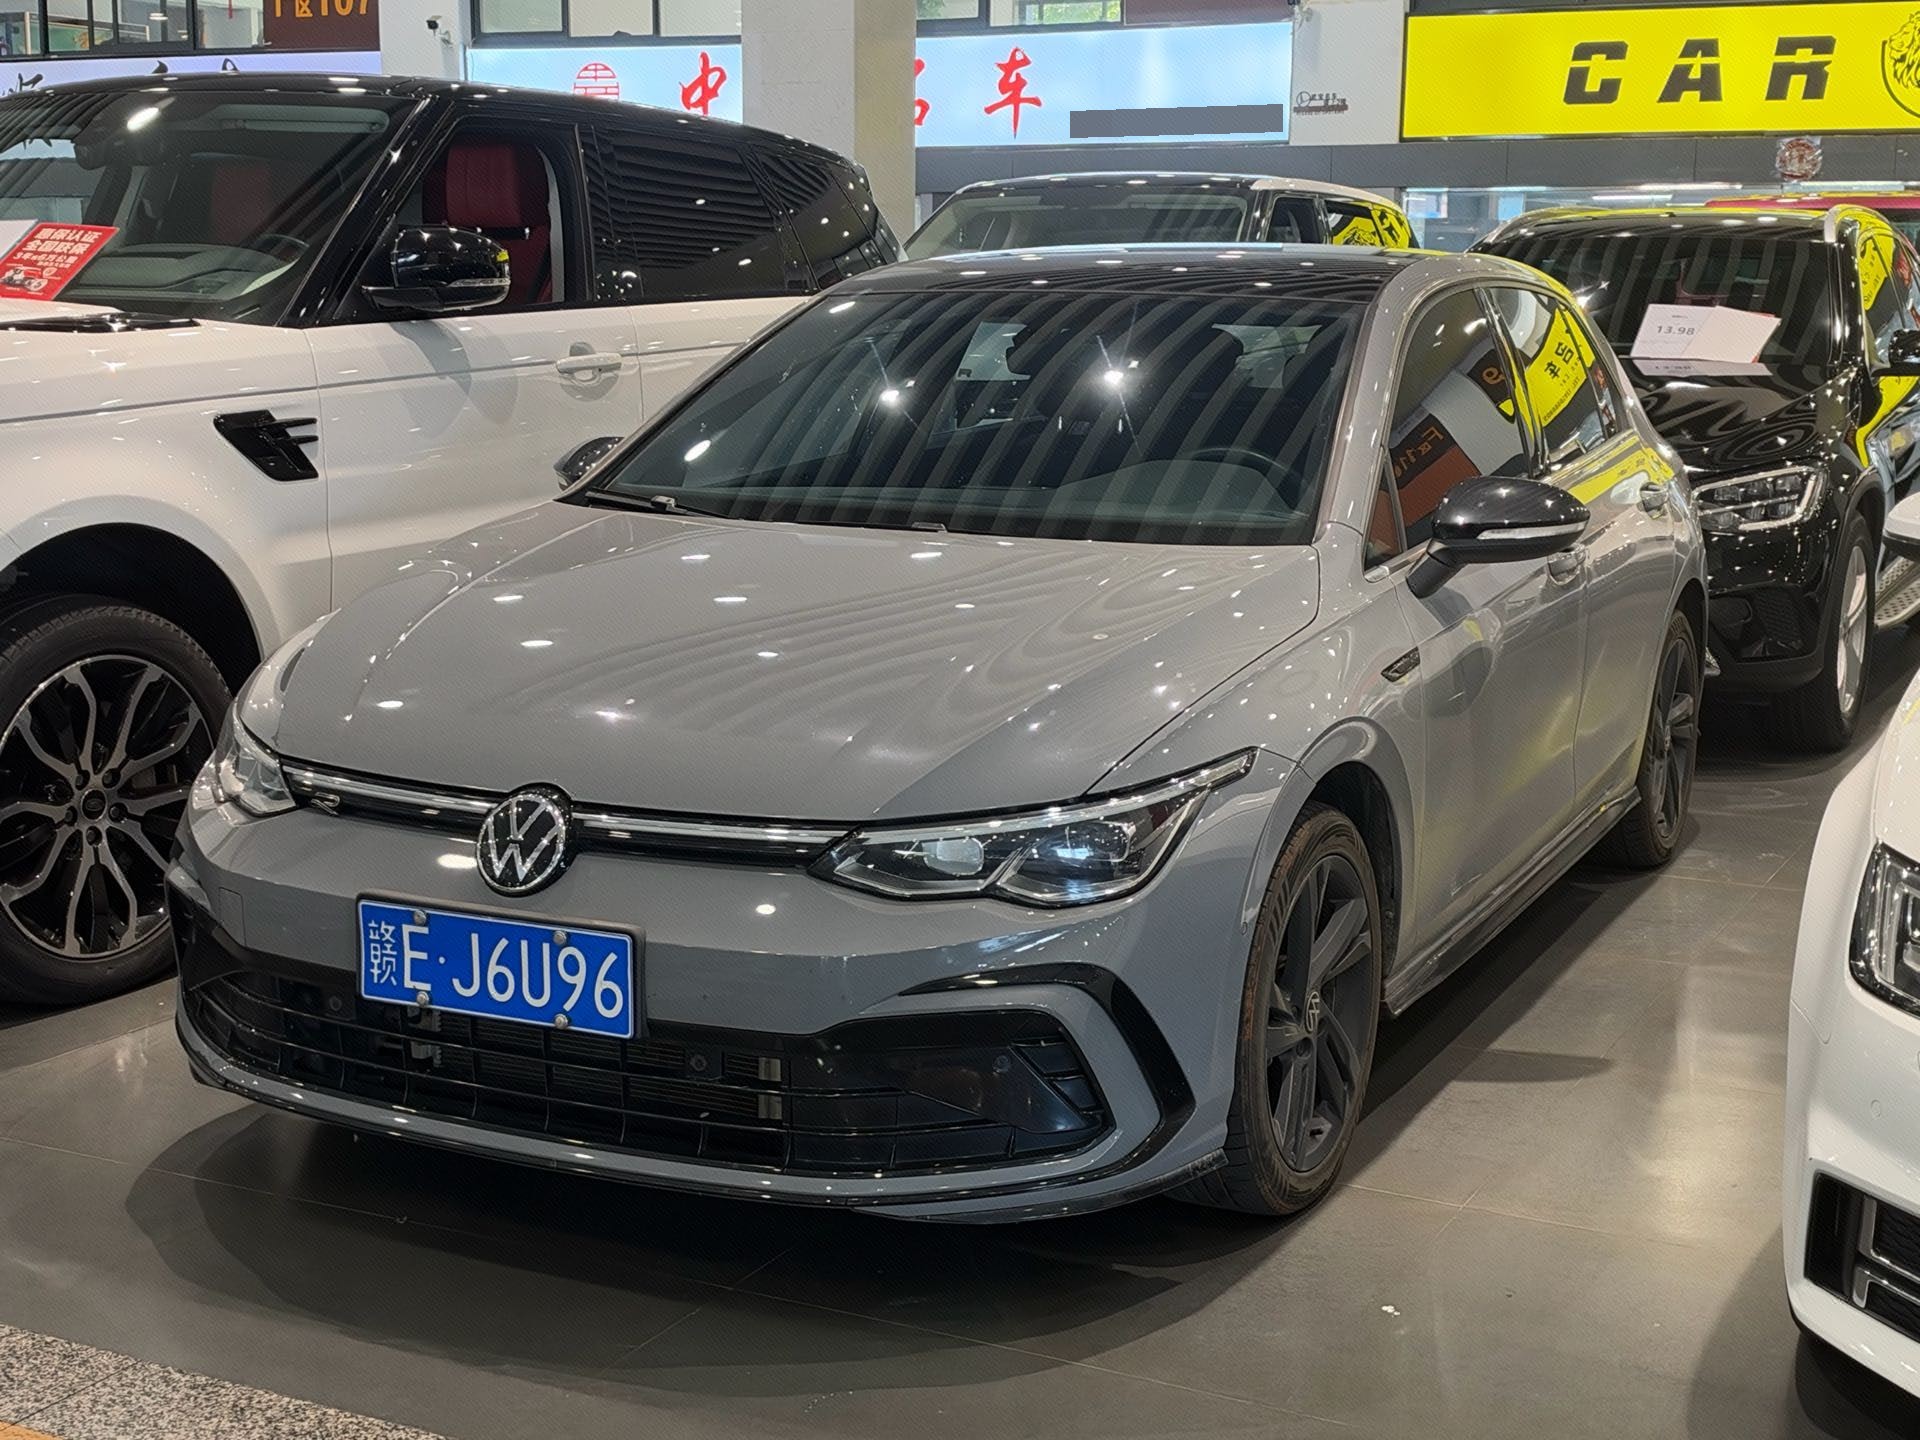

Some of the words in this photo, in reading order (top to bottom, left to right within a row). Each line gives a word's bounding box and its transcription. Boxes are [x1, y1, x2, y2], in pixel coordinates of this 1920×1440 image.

[1563, 35, 1837, 105] CAR
[1657, 325, 1695, 336] 13.98
[368, 920, 624, 1019] 赣E·J6U96
